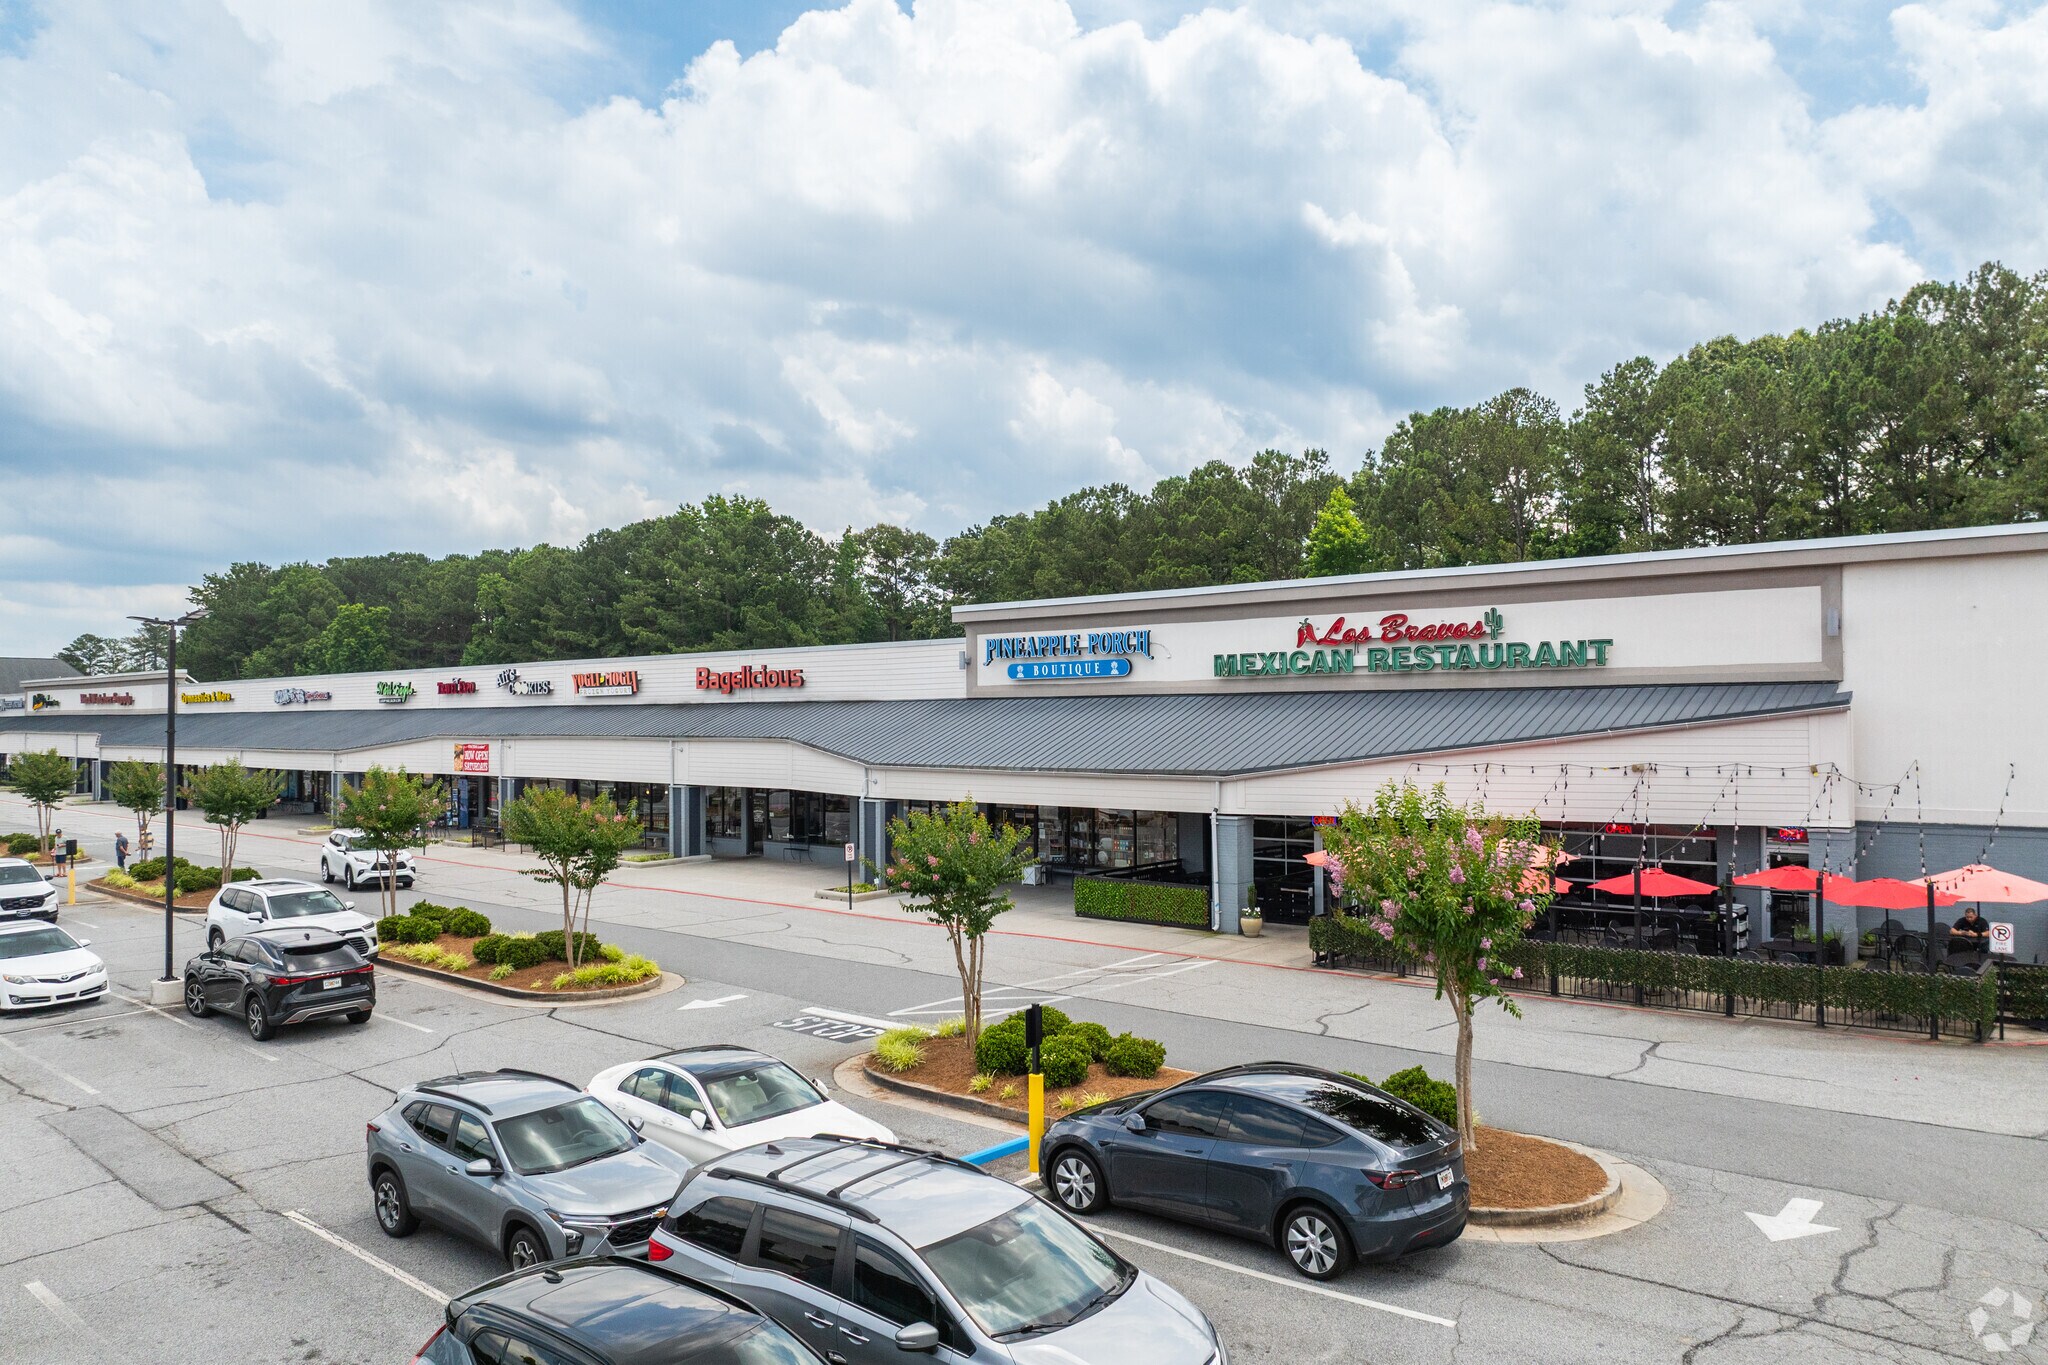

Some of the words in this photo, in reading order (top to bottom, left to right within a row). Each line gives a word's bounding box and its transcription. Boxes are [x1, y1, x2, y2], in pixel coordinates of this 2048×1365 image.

[1316, 616, 1372, 646] Los
[1379, 613, 1486, 643] Bravos
[983, 633, 1081, 666] PINEAPPLE
[1087, 630, 1154, 660] PORCH
[1213, 648, 1354, 677] MEXICAN
[1367, 638, 1614, 673] RESTAURANT
[696, 665, 804, 694] Bagelicious
[1033, 662, 1100, 677] BOUTIQUE
[508, 680, 550, 695] COOKIES
[572, 673, 601, 694] YOGLI
[605, 671, 637, 692] MOGLI
[181, 692, 211, 704] Gymnastics
[217, 690, 231, 702] More
[475, 750, 489, 761] OPEN
[1605, 824, 1632, 834] OPEN
[773, 1016, 885, 1039] STOP
